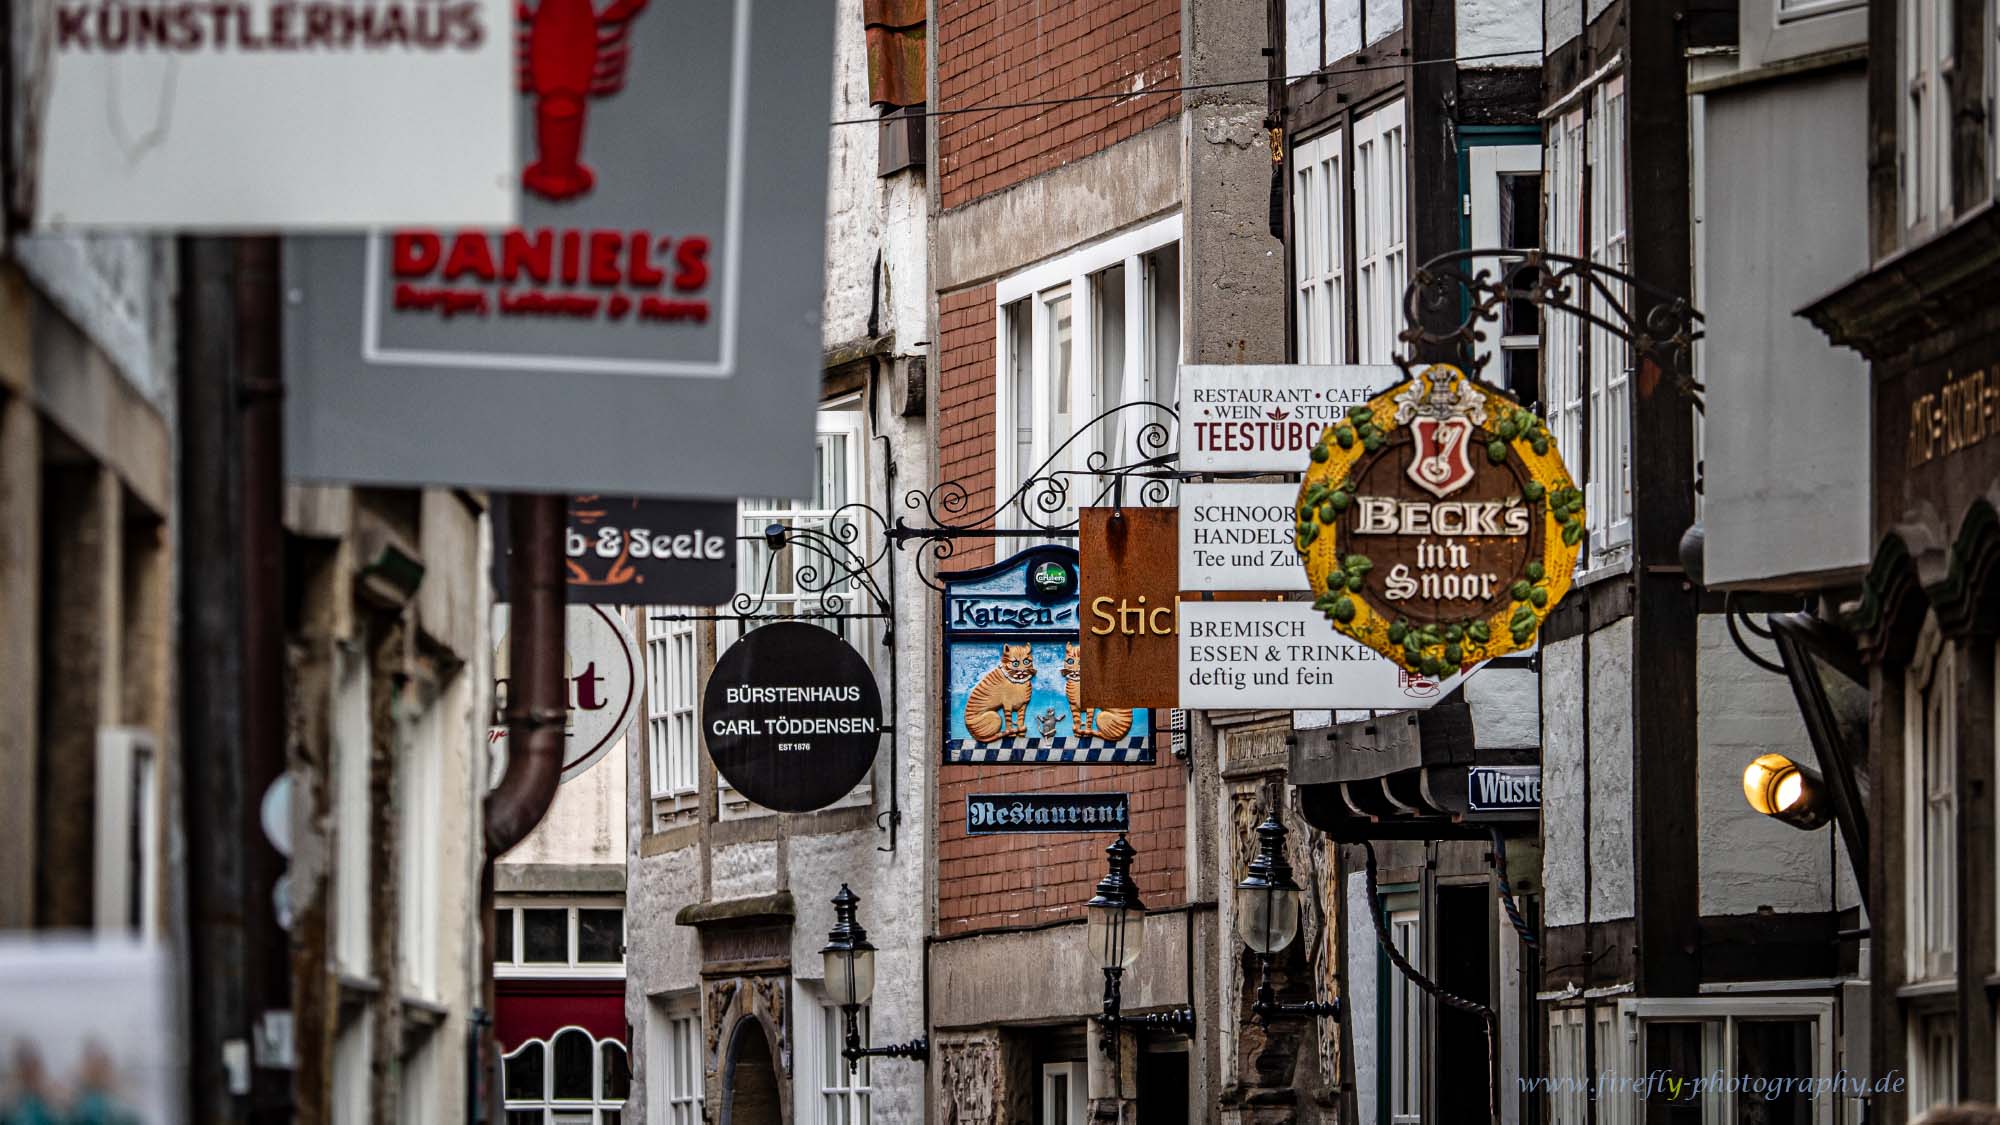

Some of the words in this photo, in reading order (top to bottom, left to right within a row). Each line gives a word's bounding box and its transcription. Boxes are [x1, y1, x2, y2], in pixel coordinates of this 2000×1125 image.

[392, 228, 710, 291] DANIEL'S
[1193, 389, 1312, 403] RESTAURANT
[1326, 385, 1373, 403] CAFÉ
[1214, 405, 1262, 419] WEIN
[1194, 421, 1337, 451] TEESTÜBC
[1193, 505, 1296, 522] SCHNOOR
[629, 528, 725, 559] Seele
[1193, 550, 1225, 567] Tee
[1231, 550, 1264, 567] und
[1385, 563, 1497, 600] Snoor
[1190, 621, 1305, 638] BREMISCH
[1190, 645, 1258, 662] ESSEN
[1265, 645, 1282, 662] &
[1189, 667, 1246, 690] deftig
[1253, 667, 1289, 686] und
[1296, 667, 1334, 686] fein
[726, 684, 860, 703] BÜRSTENHAUS
[712, 719, 762, 736] CARL
[764, 716, 875, 735] TÖDDENSEN
[778, 743, 793, 751] EST
[970, 801, 1126, 827] Restaurant
